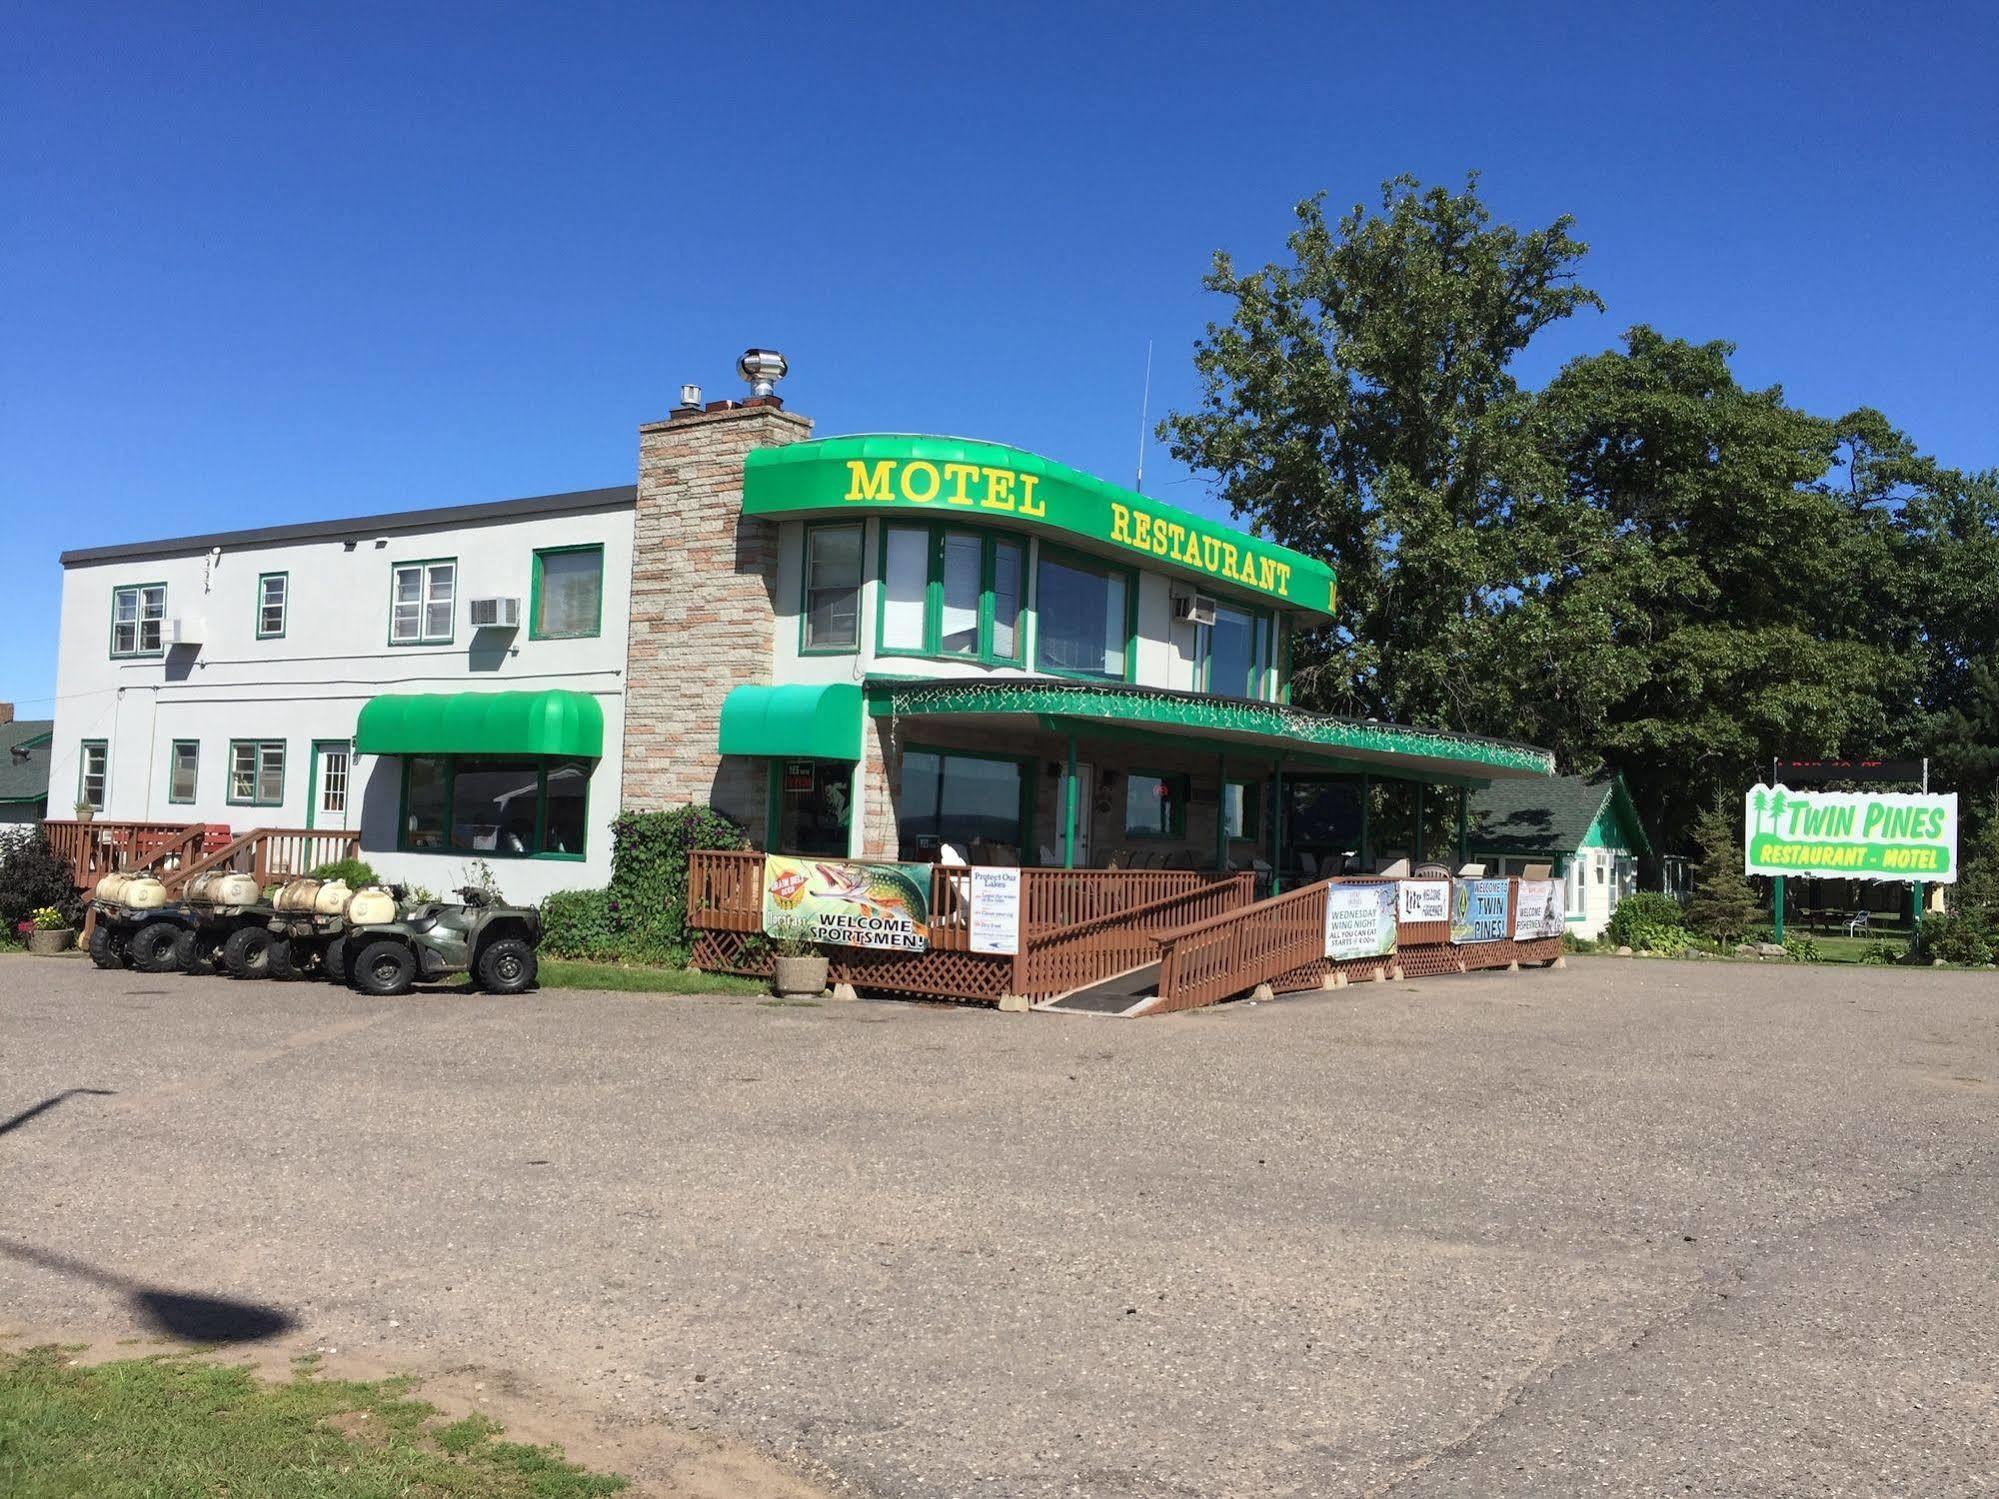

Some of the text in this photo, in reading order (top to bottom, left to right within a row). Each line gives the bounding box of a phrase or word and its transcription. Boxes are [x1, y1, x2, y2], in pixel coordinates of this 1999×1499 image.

[844, 460, 1046, 517] MOTEL
[1110, 503, 1291, 596] RESTAURANT
[1787, 801, 1945, 839] TWIN PINES
[1760, 844, 1869, 866] RESTAURANT
[1883, 848, 1938, 869] MOTEL
[974, 872, 1016, 882] Protect Our
[984, 880, 1006, 888] Lakes
[1474, 881, 1500, 893] WELCOME
[1405, 889, 1422, 914] Lite
[1477, 897, 1504, 915] TWIN
[1332, 909, 1377, 919] WEDNESDAY
[1519, 906, 1541, 917] WELCOME
[819, 914, 912, 933] WELCOME
[1332, 919, 1376, 930] WING NIGHT
[1474, 920, 1505, 939] PINES!
[811, 926, 925, 948] SPORTSMEN!
[1329, 928, 1377, 939] ALL YOU CAN EAT
